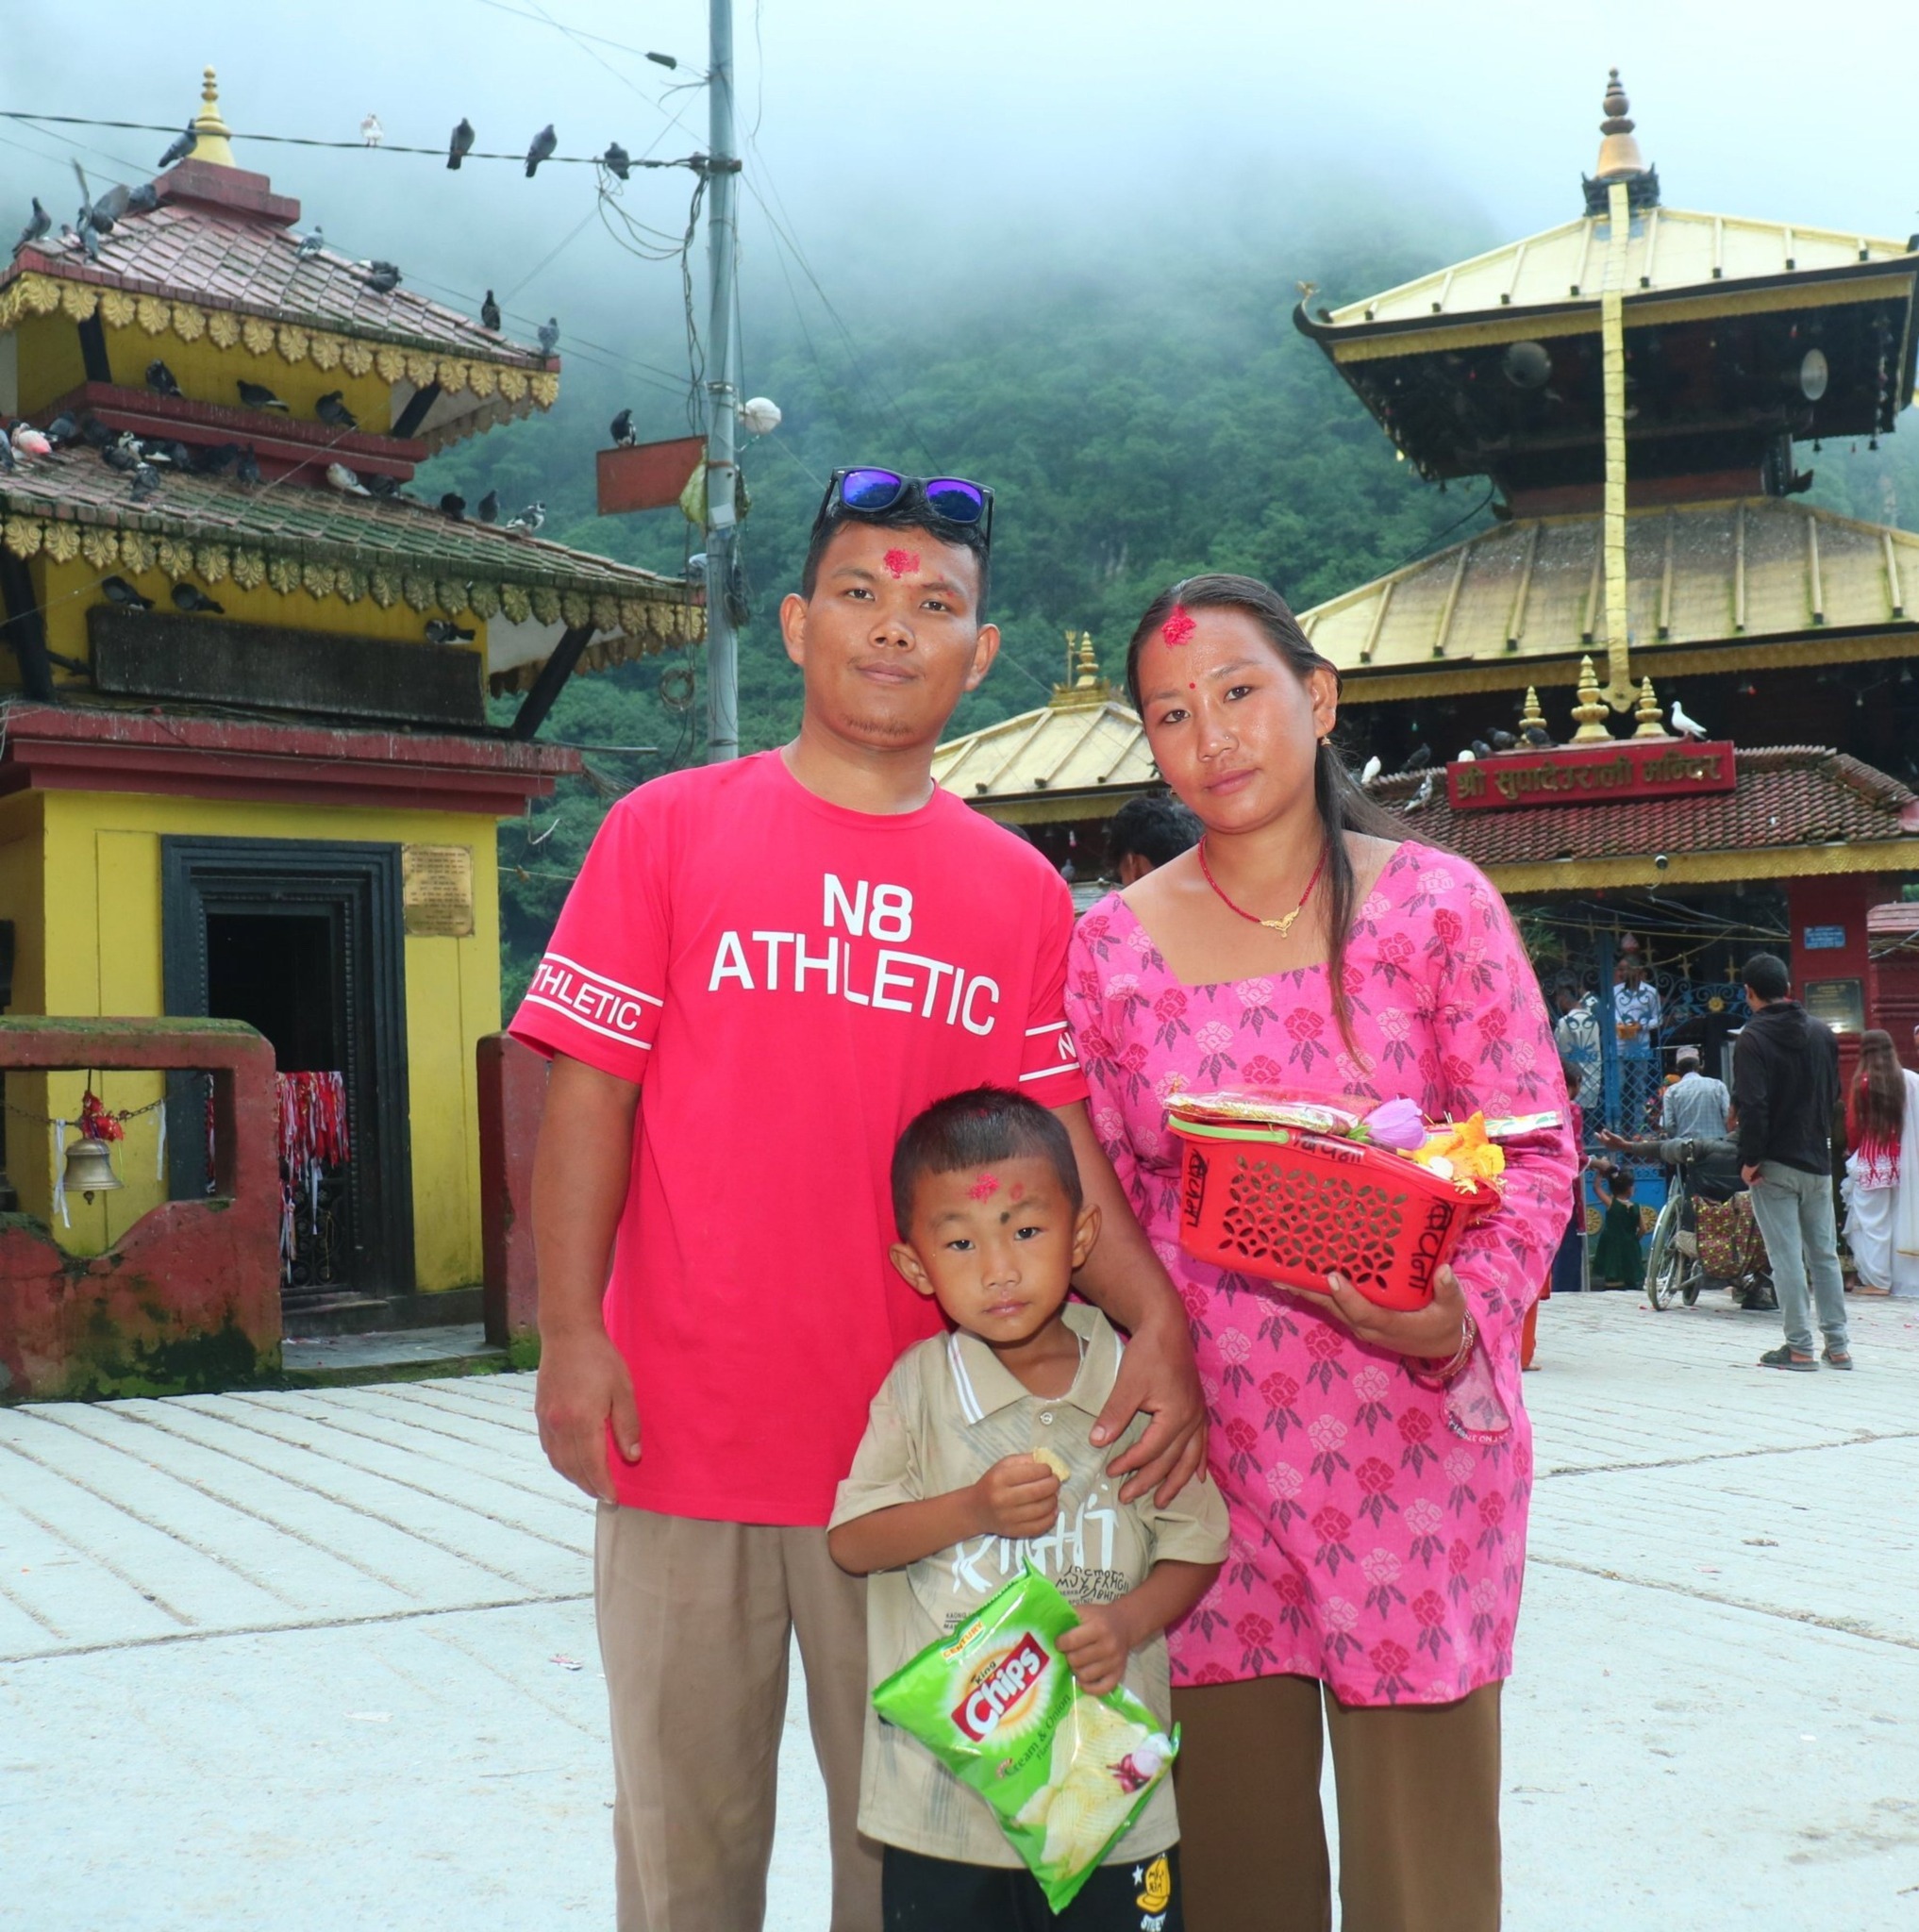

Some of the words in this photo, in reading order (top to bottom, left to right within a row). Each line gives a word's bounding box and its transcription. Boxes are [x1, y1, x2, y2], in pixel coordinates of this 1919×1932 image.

[1456, 766, 1487, 800] श्री
[823, 873, 913, 942] N8
[531, 963, 642, 1031] THLETIC
[708, 931, 1000, 1036] ATHLETIC
[1058, 1032, 1076, 1060] N
[943, 1621, 984, 1658] CENTURY
[965, 1647, 1041, 1736] Chips
[1004, 1742, 1039, 1777] Cream
[1045, 1693, 1071, 1730] Onion
